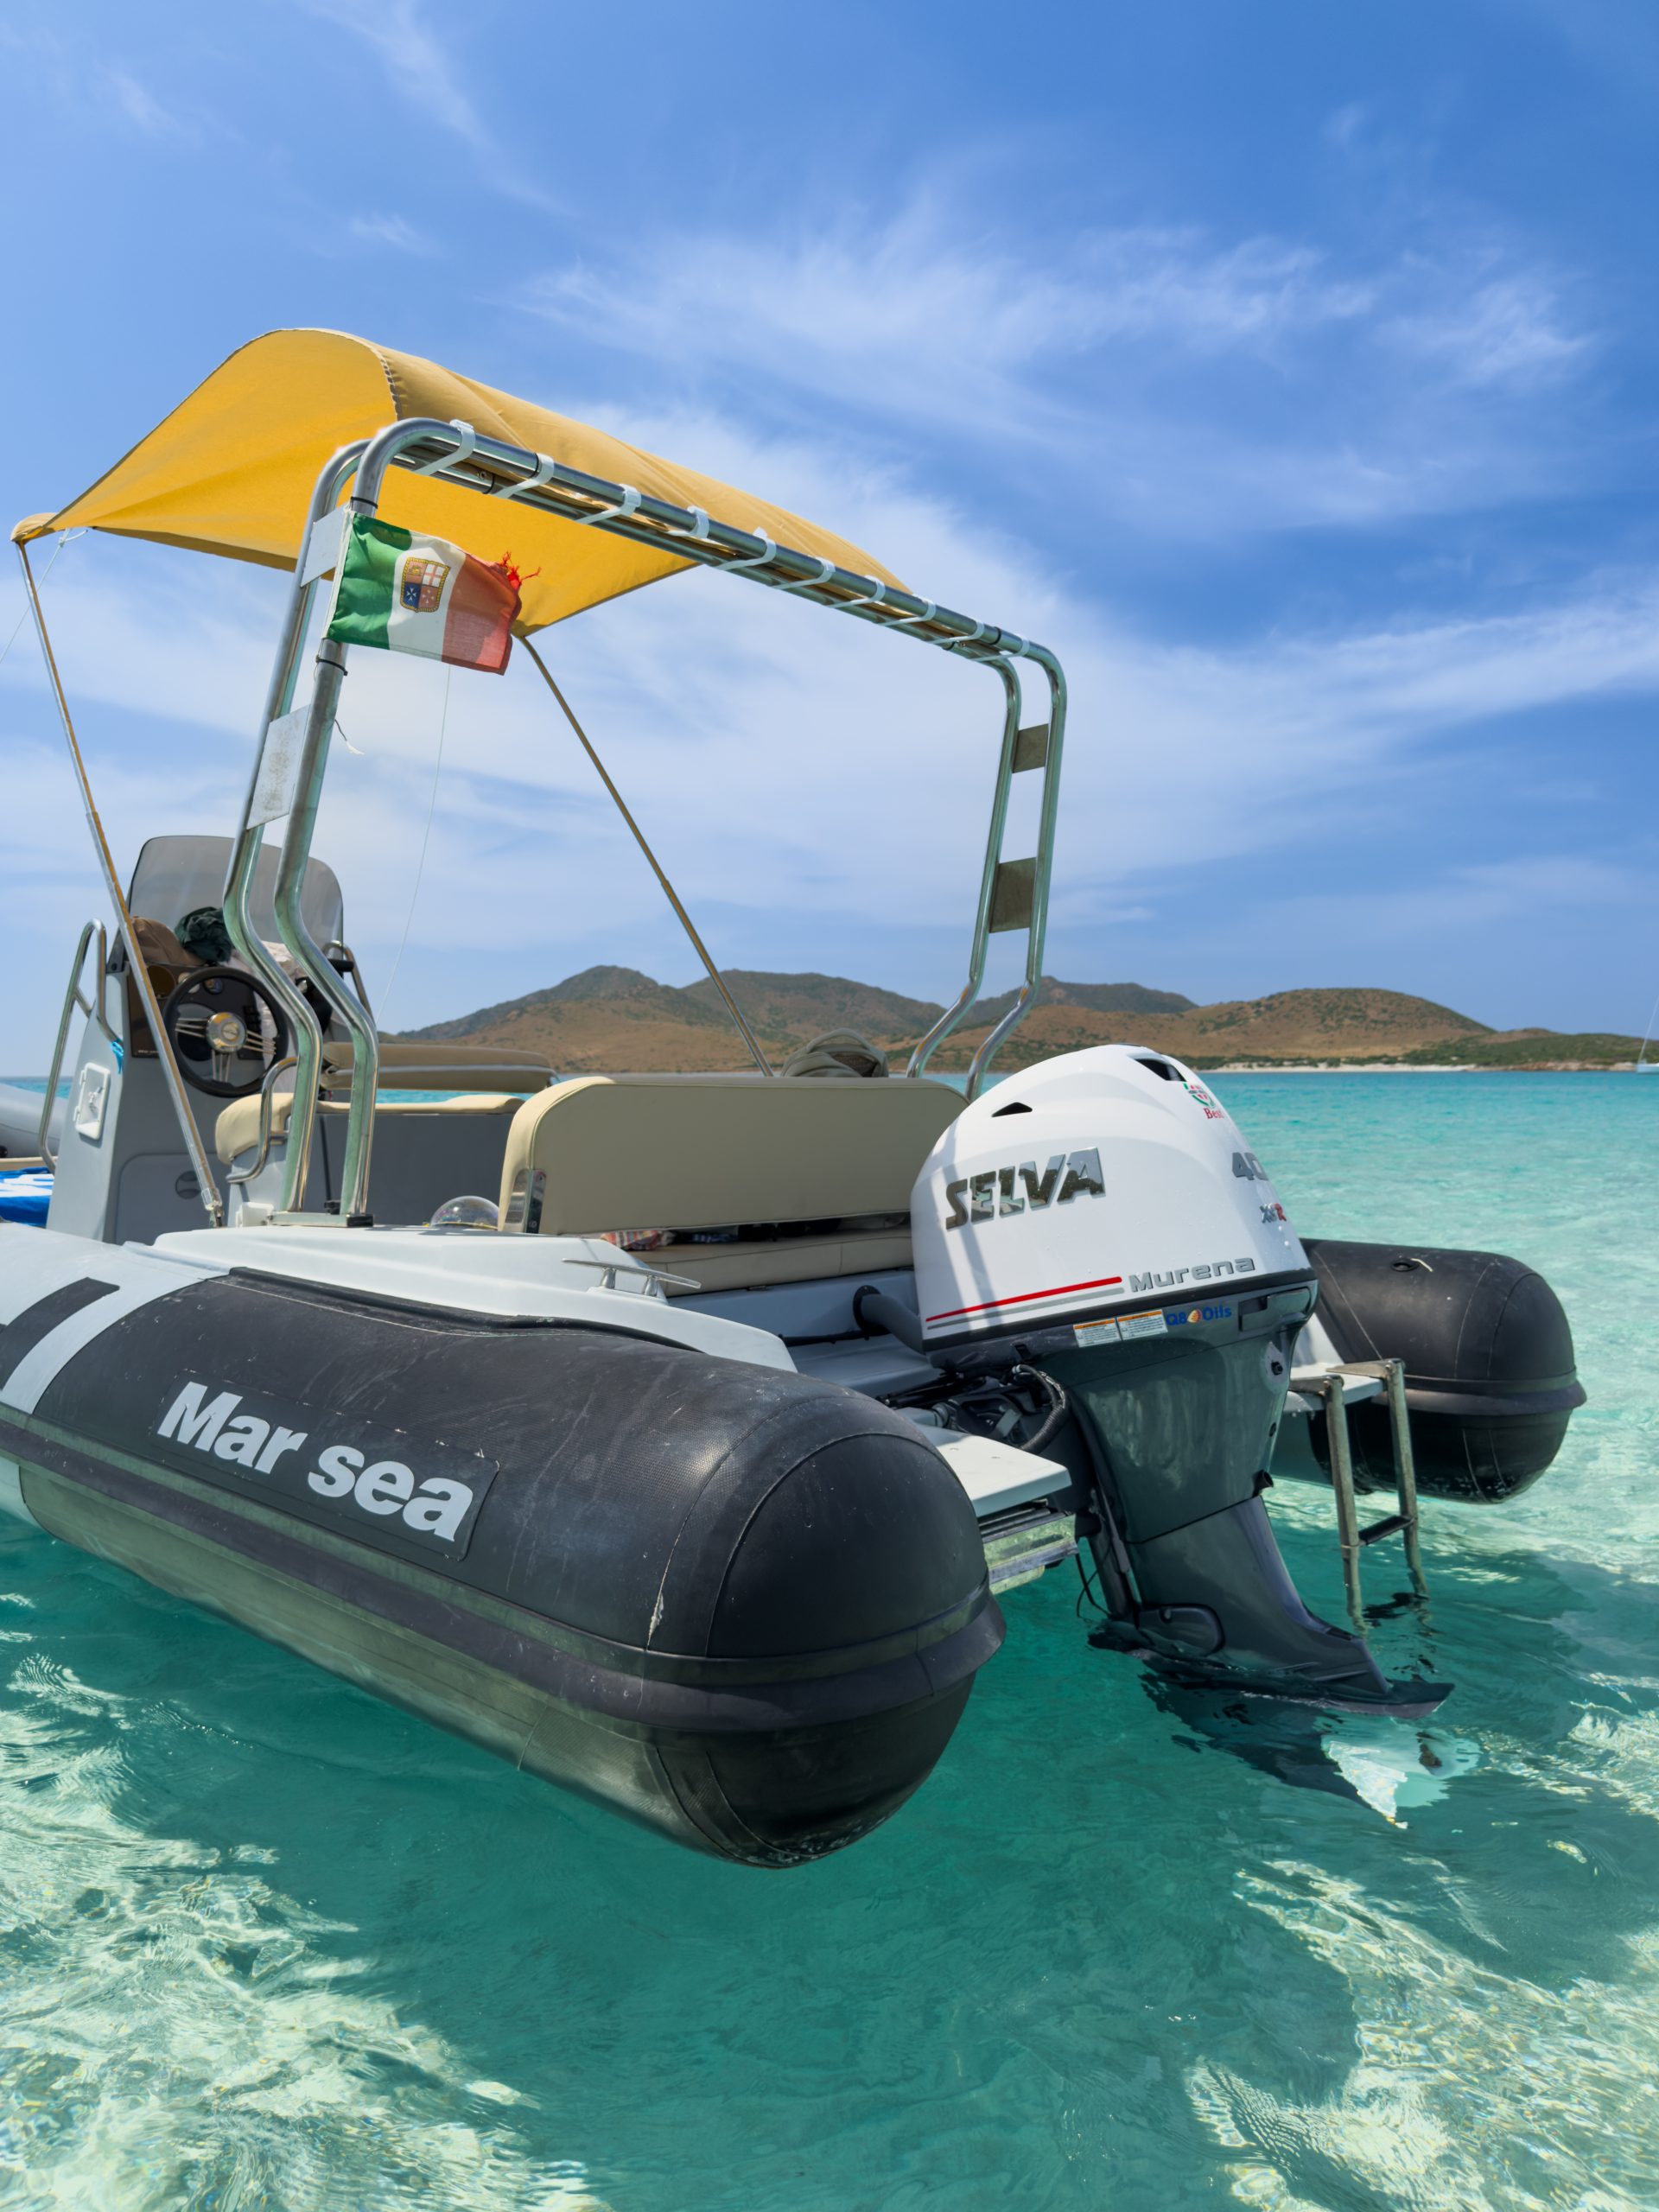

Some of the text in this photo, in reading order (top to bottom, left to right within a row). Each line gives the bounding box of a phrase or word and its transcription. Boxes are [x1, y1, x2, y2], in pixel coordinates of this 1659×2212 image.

[945, 1147, 1106, 1231] SELVA
[1128, 1257, 1255, 1293] Murena
[1166, 1312, 1186, 1325] Q8
[1202, 1305, 1232, 1321] Oils
[157, 1381, 474, 1541] Mar sea
